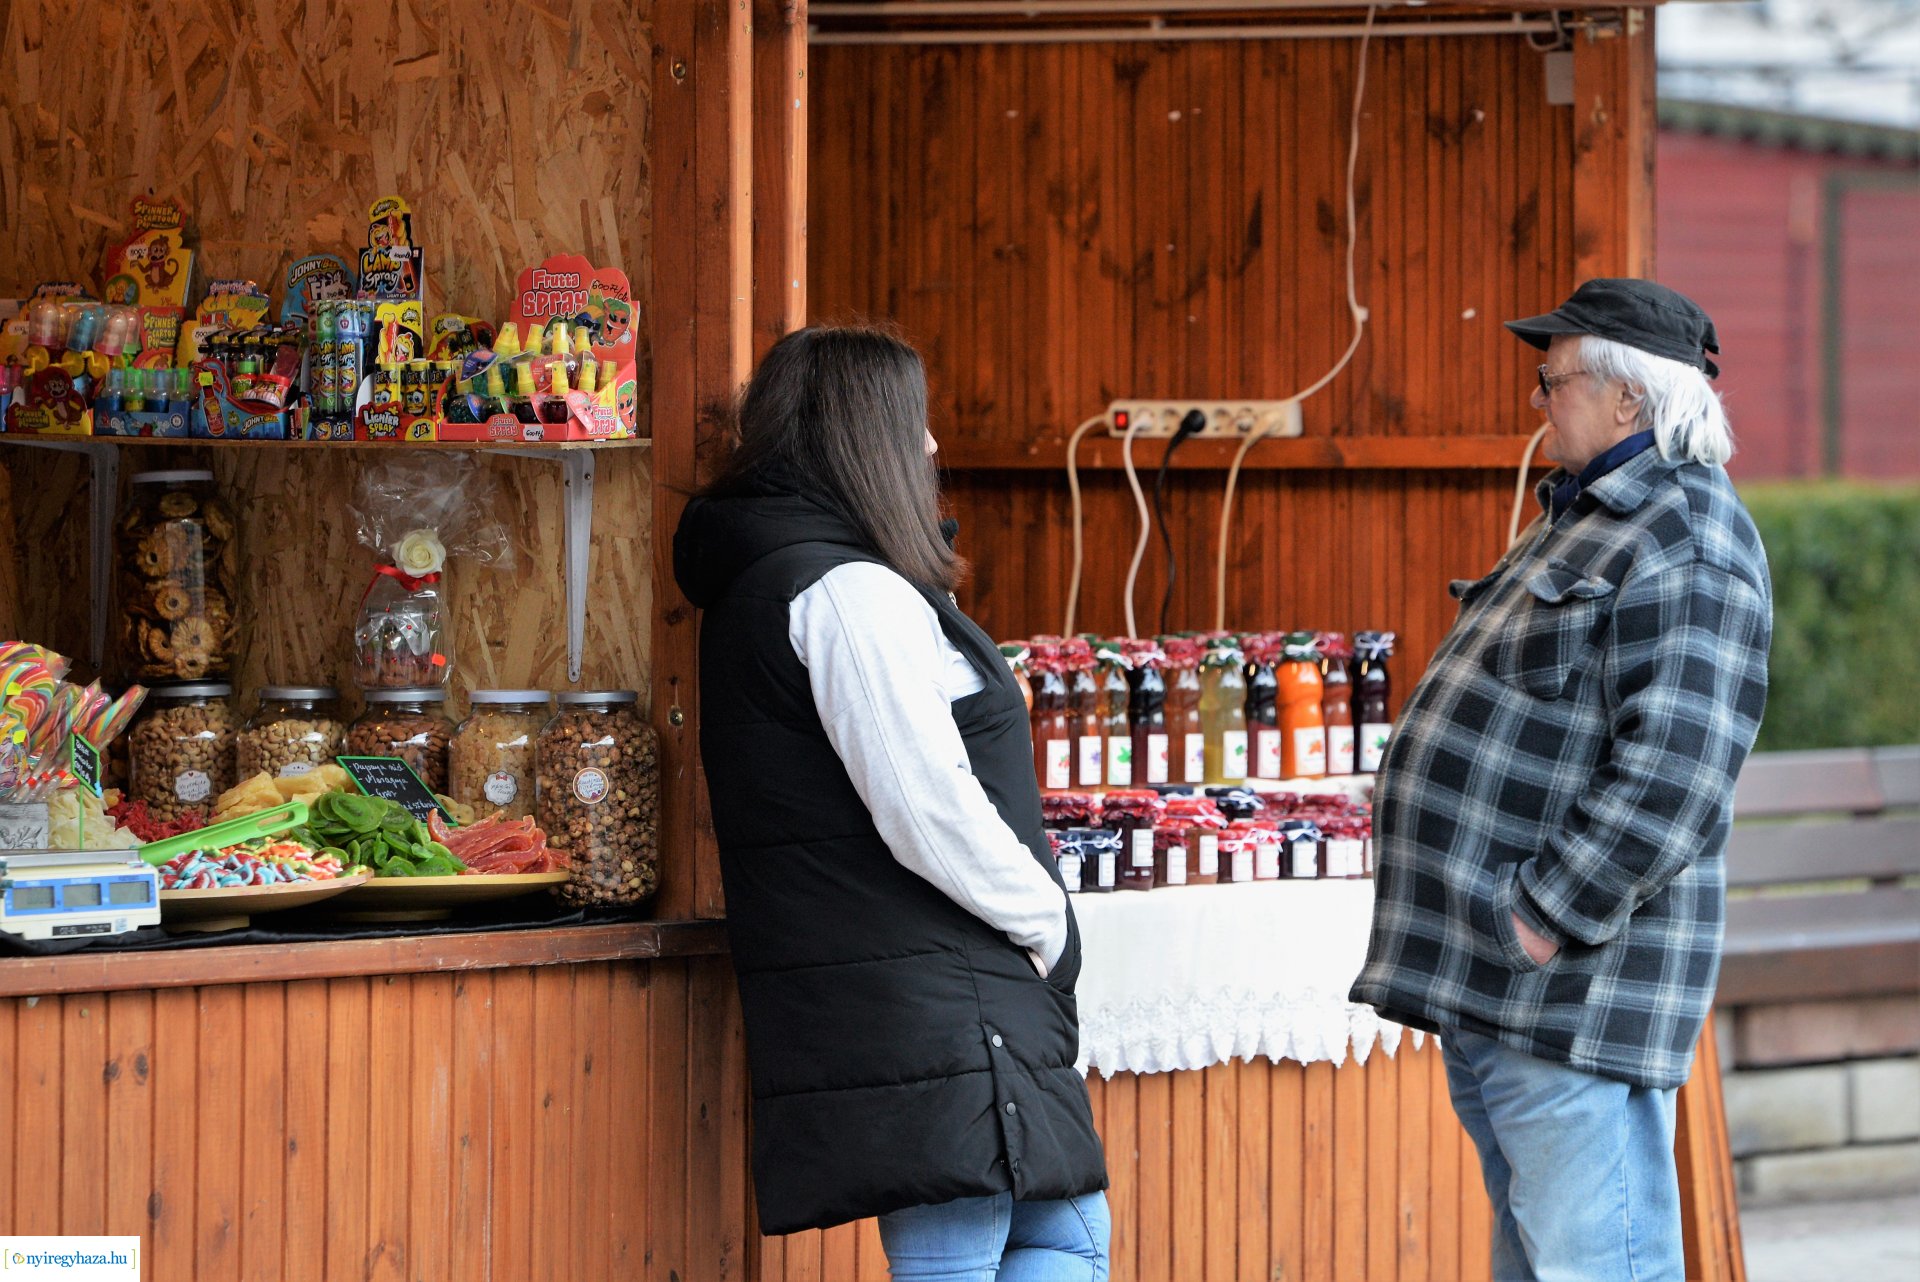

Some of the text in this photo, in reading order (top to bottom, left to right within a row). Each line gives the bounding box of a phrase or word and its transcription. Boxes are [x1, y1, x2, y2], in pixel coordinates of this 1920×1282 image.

[289, 259, 322, 284] JOHNY
[241, 416, 264, 435] JOHNY
[363, 411, 399, 426] LIGHTER
[368, 422, 394, 432] SPRAY
[414, 423, 429, 437] JB
